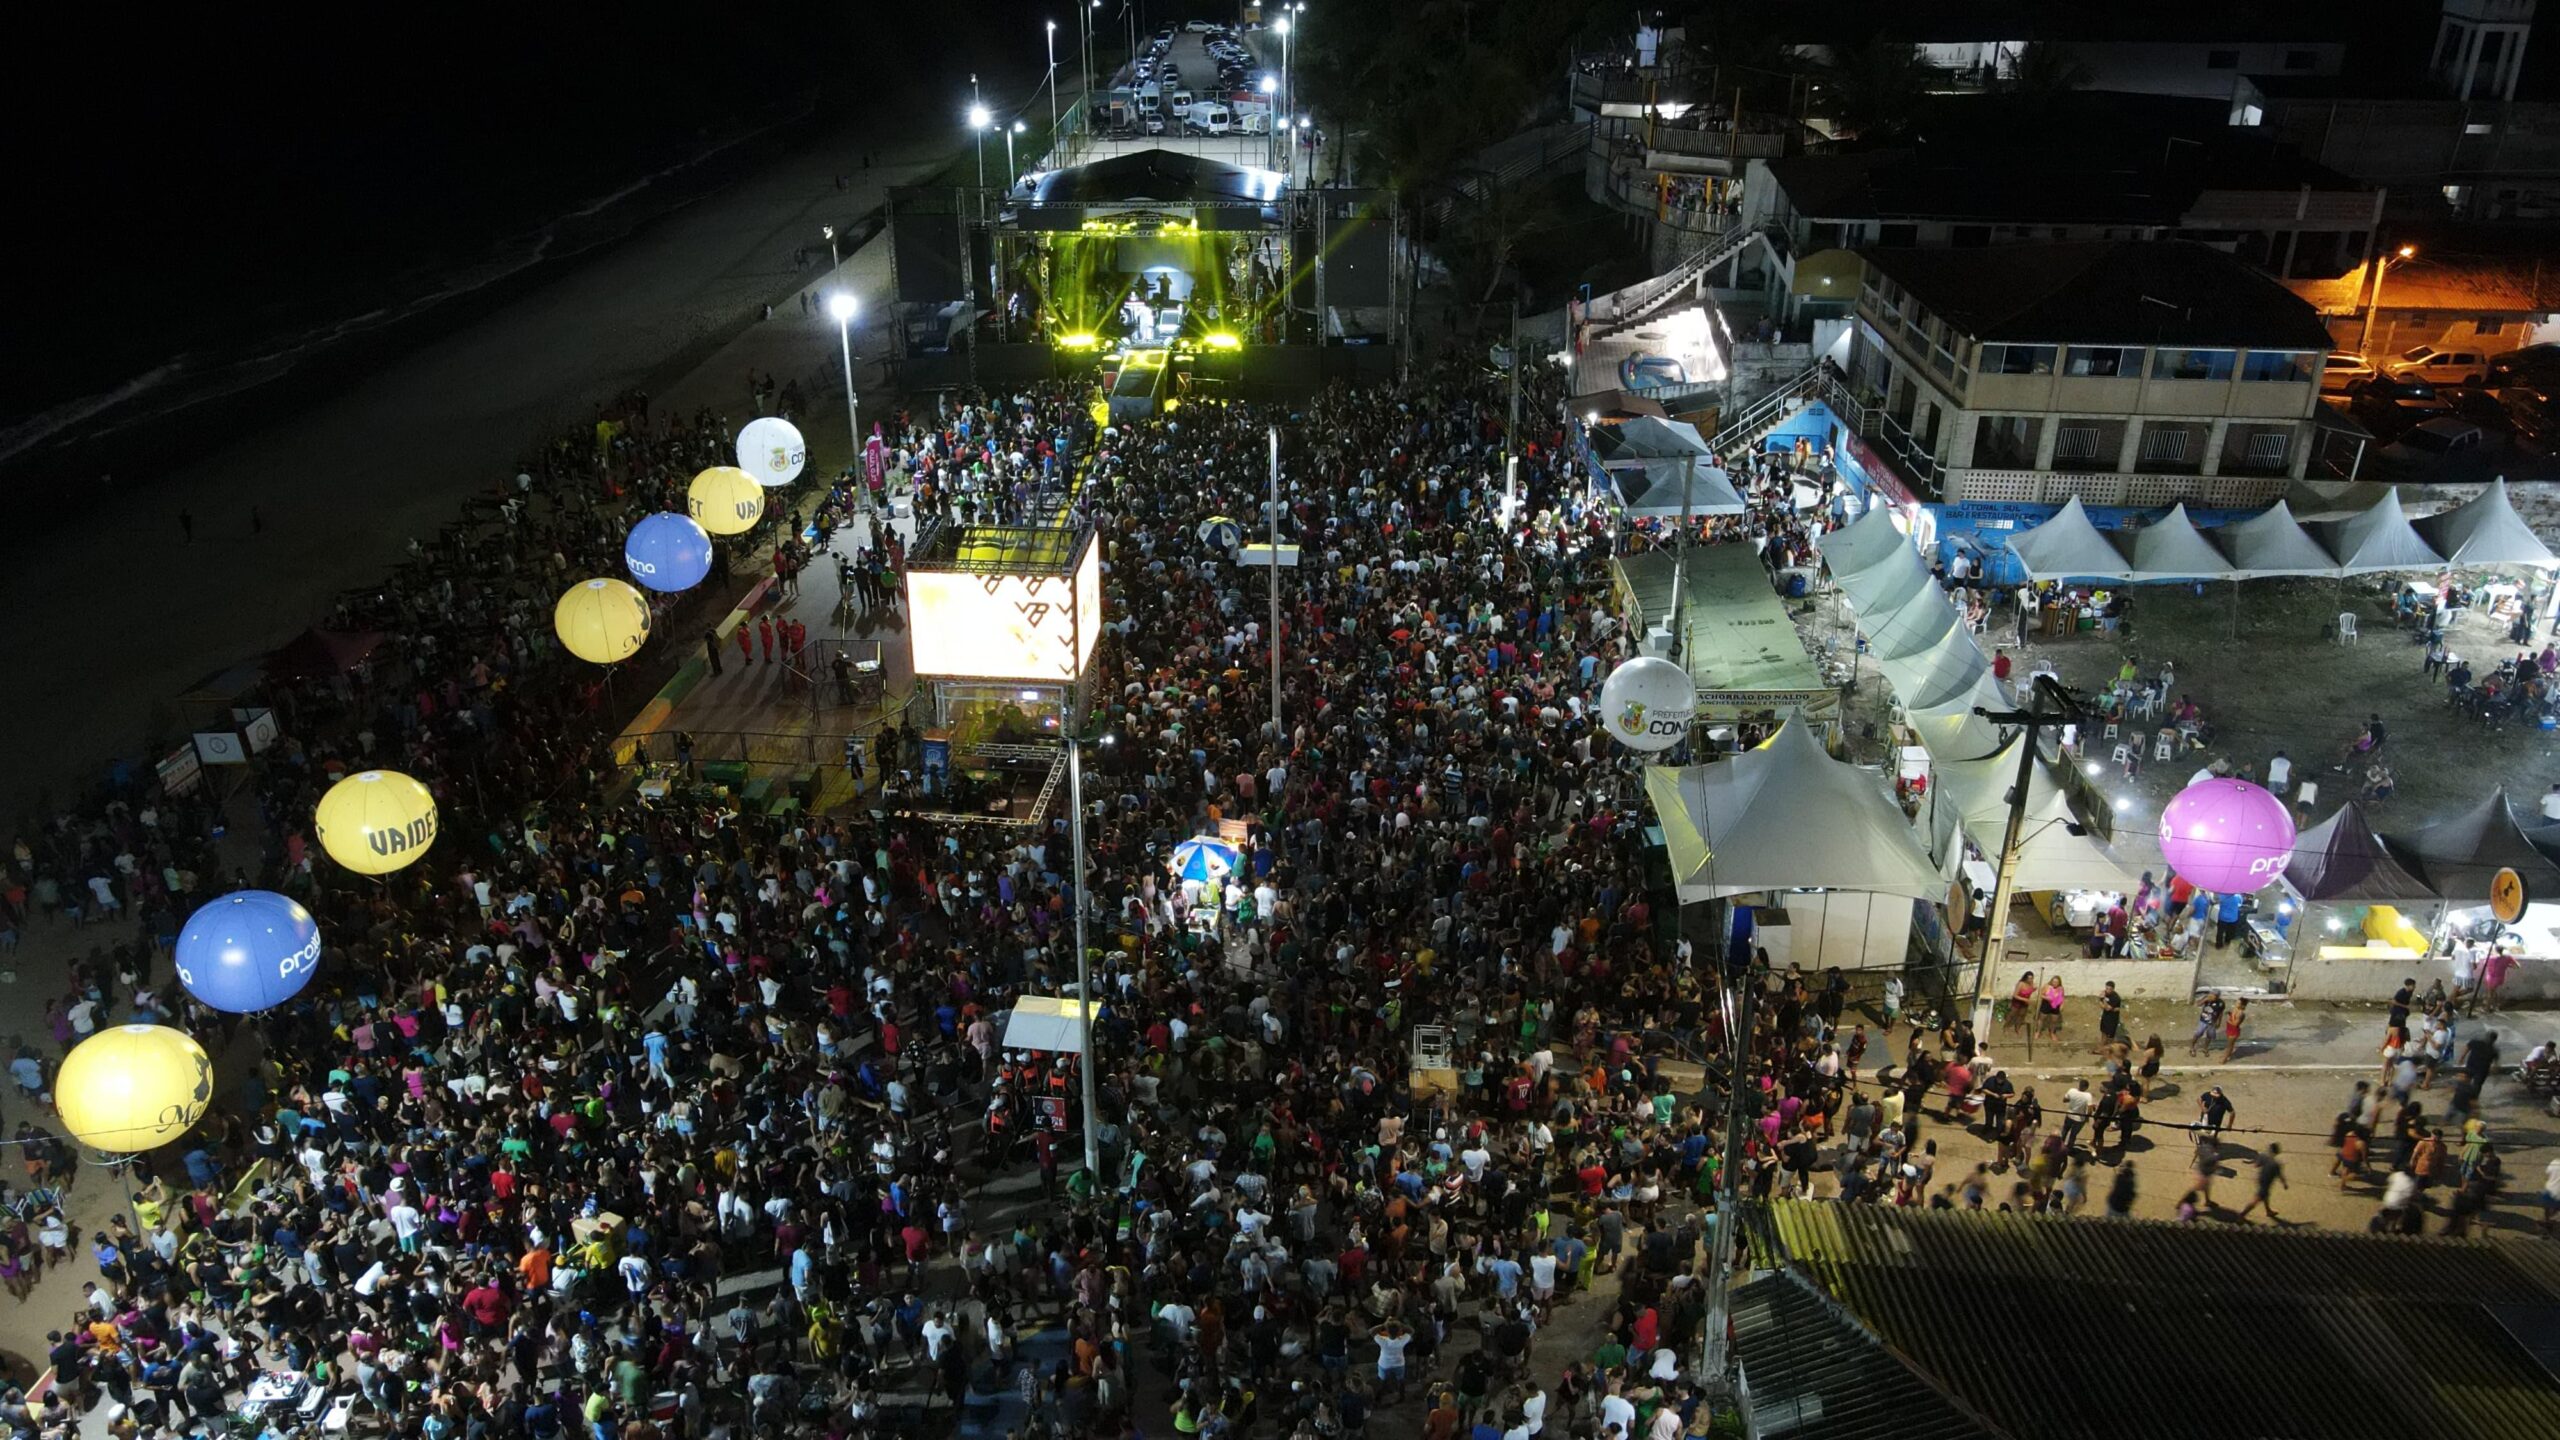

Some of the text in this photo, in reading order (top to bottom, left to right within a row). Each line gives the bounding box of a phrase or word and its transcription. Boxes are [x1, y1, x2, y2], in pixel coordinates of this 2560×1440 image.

[1961, 503, 2022, 512] LITORAL SUL
[1945, 511, 1965, 520] BAR
[1757, 693, 1772, 701] DO
[1774, 692, 1810, 701] NALDO
